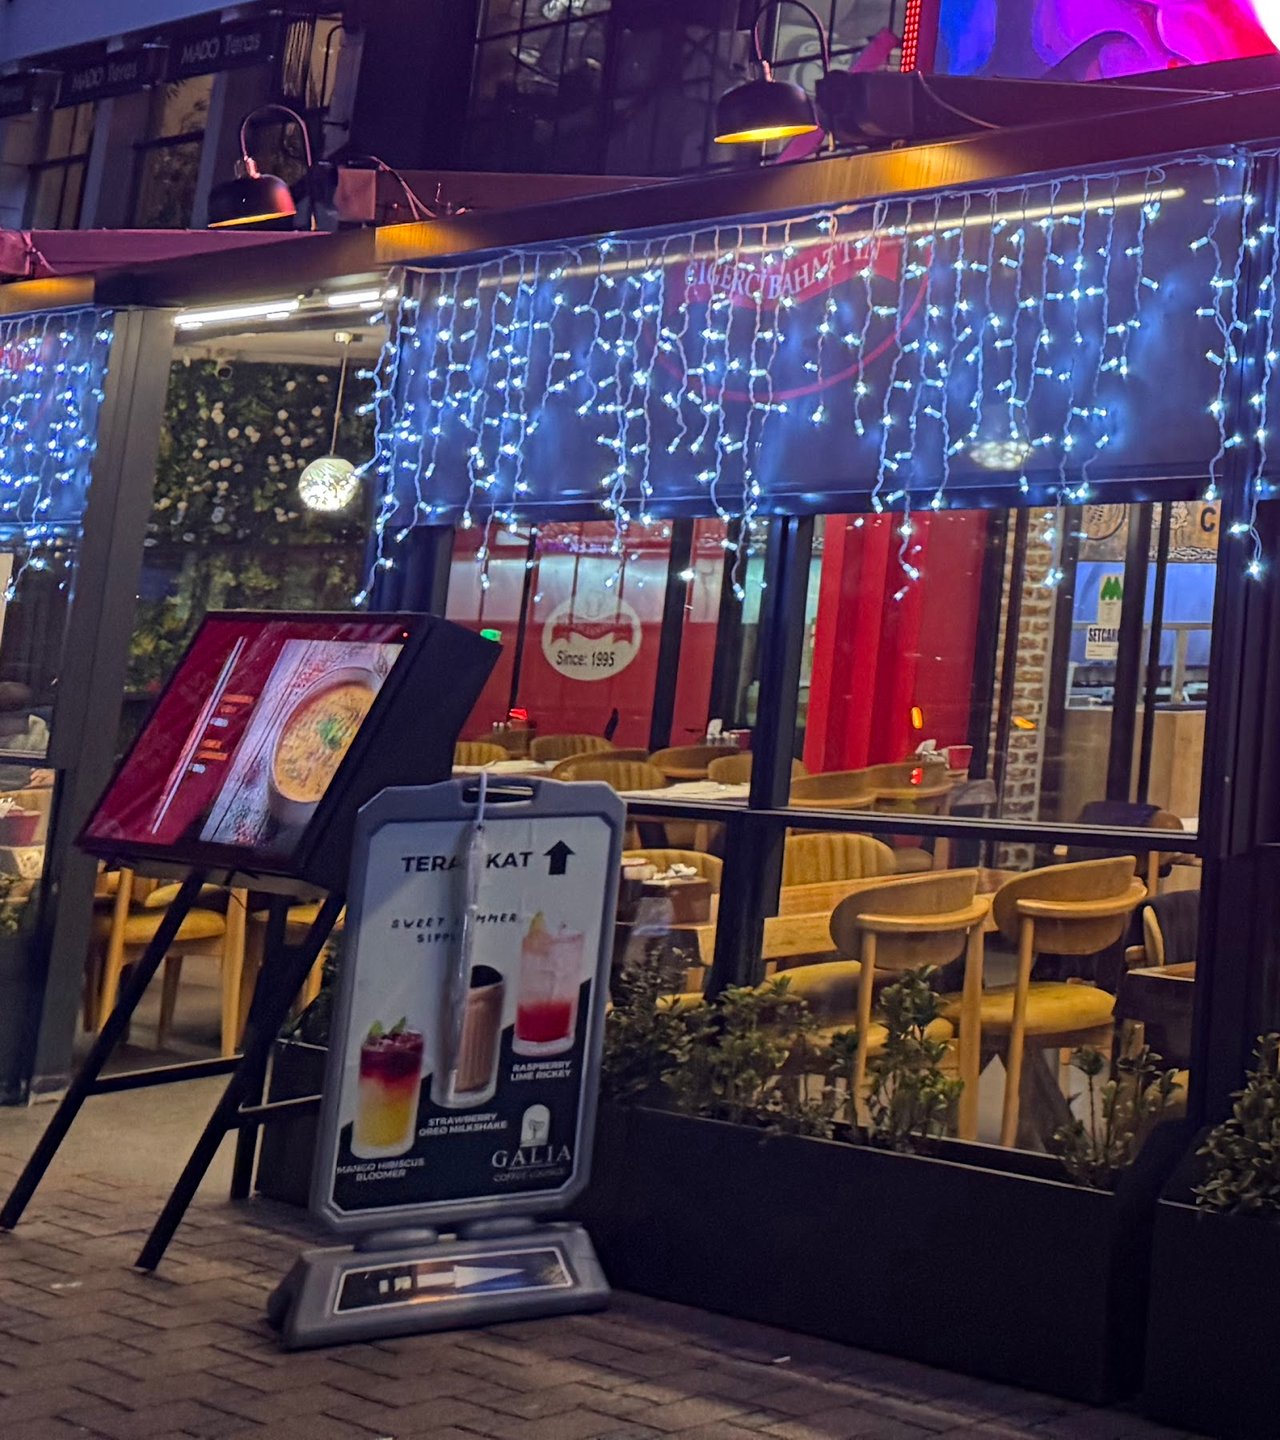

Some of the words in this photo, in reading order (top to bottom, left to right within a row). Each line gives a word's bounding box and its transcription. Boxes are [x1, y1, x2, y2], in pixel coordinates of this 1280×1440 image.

[556, 650, 587, 667] Since:
[591, 651, 616, 668] 1995
[401, 855, 464, 874] TERA
[486, 850, 534, 869] KAT
[391, 917, 445, 930] SWEET
[427, 1112, 498, 1127] STRAWBERRY
[418, 1125, 449, 1137] OREO
[491, 1144, 572, 1168] GALIA
[355, 1168, 407, 1182] BLOOMER
